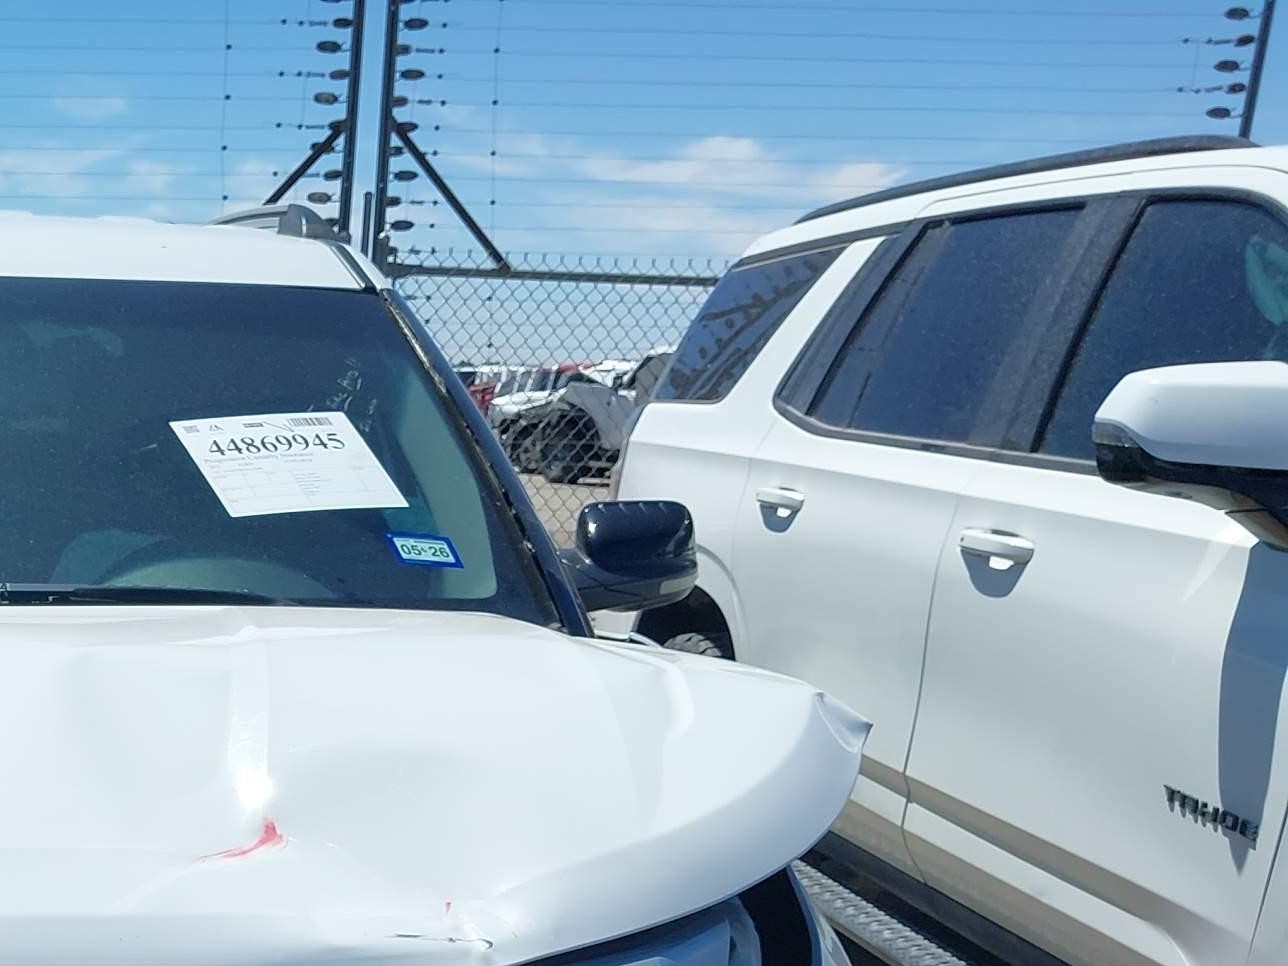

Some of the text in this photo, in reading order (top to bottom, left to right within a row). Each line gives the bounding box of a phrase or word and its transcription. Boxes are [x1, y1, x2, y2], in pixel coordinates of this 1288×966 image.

[208, 431, 346, 457] 44869945
[400, 544, 450, 558] 05 26
[1163, 784, 1260, 843] TAHOE
